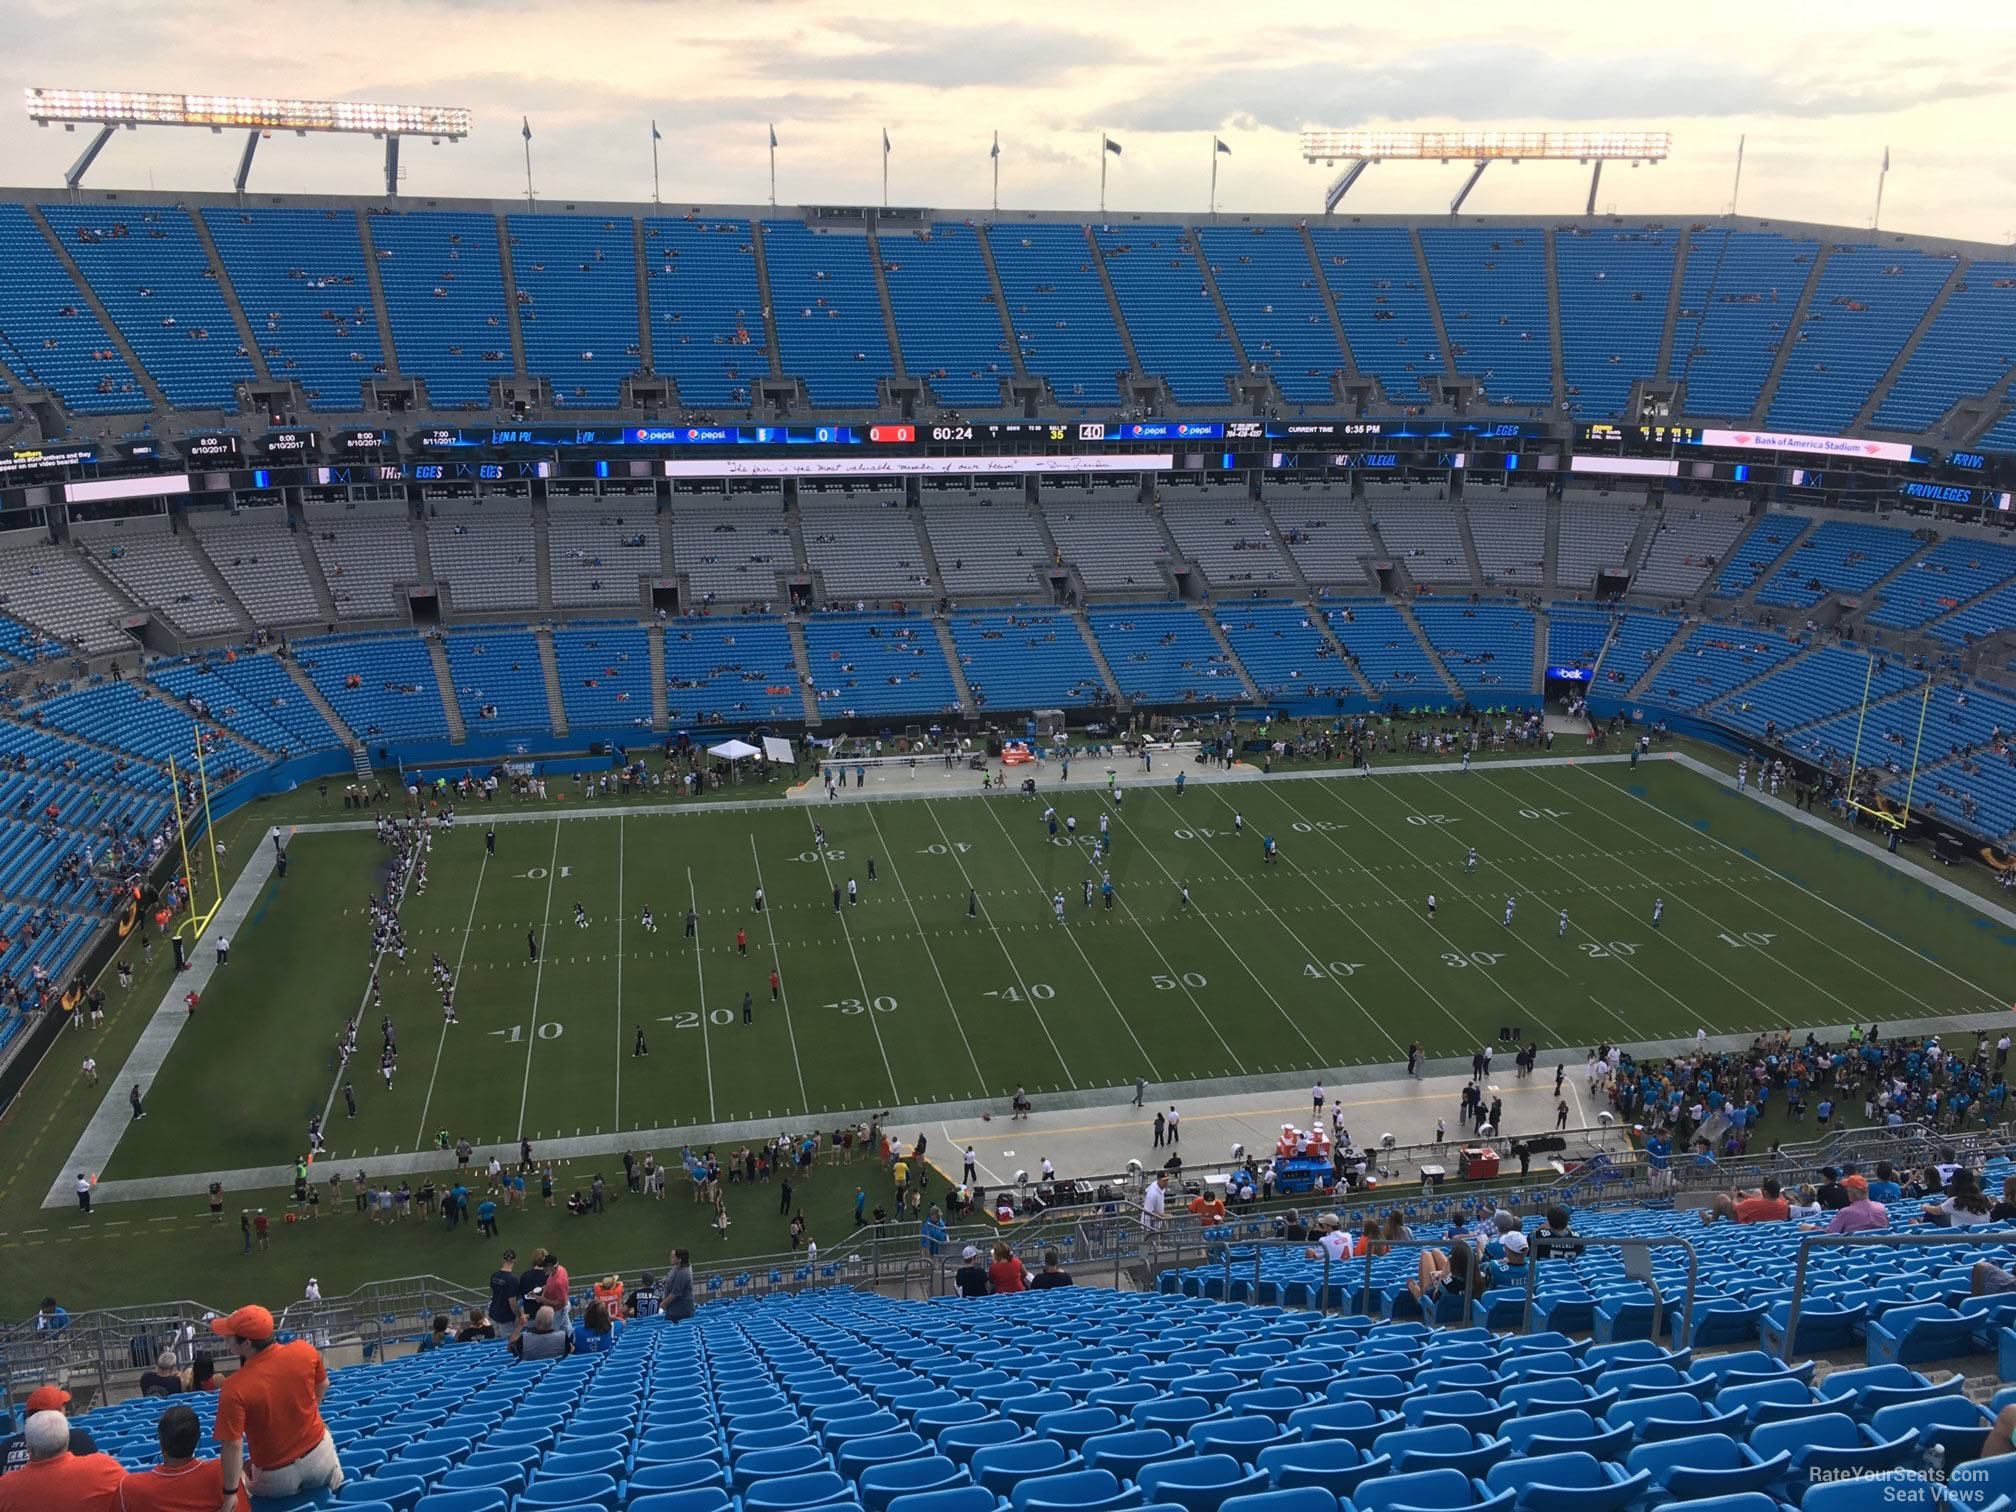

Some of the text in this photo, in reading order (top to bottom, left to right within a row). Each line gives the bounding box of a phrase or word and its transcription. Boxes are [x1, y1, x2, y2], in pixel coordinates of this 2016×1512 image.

[818, 429, 828, 441] 0
[897, 429, 907, 441] 0
[933, 427, 973, 440] 60:24
[1083, 426, 1100, 438] 40
[1144, 427, 1166, 436] pepsi
[1190, 426, 1211, 435] pepsi
[1345, 425, 1380, 433] 6:35 PM
[650, 431, 675, 441] pepsi
[701, 431, 726, 441] pepsi
[1050, 431, 1064, 440] 35
[269, 441, 304, 450] 8/10/2017
[347, 439, 382, 447] 8/10/2017
[1755, 436, 1861, 452] Bank of America Stadium
[192, 446, 227, 454] 8/10/2017
[1717, 930, 1771, 949] 10
[1579, 940, 1637, 959] 20
[1440, 950, 1498, 968] 30
[1302, 961, 1356, 980] 40
[1152, 972, 1208, 991] 50
[1001, 983, 1056, 1002] 40
[841, 995, 898, 1015] 30
[674, 1008, 735, 1029] 20
[504, 1022, 564, 1043] 10
[637, 1299, 659, 1317] 50
